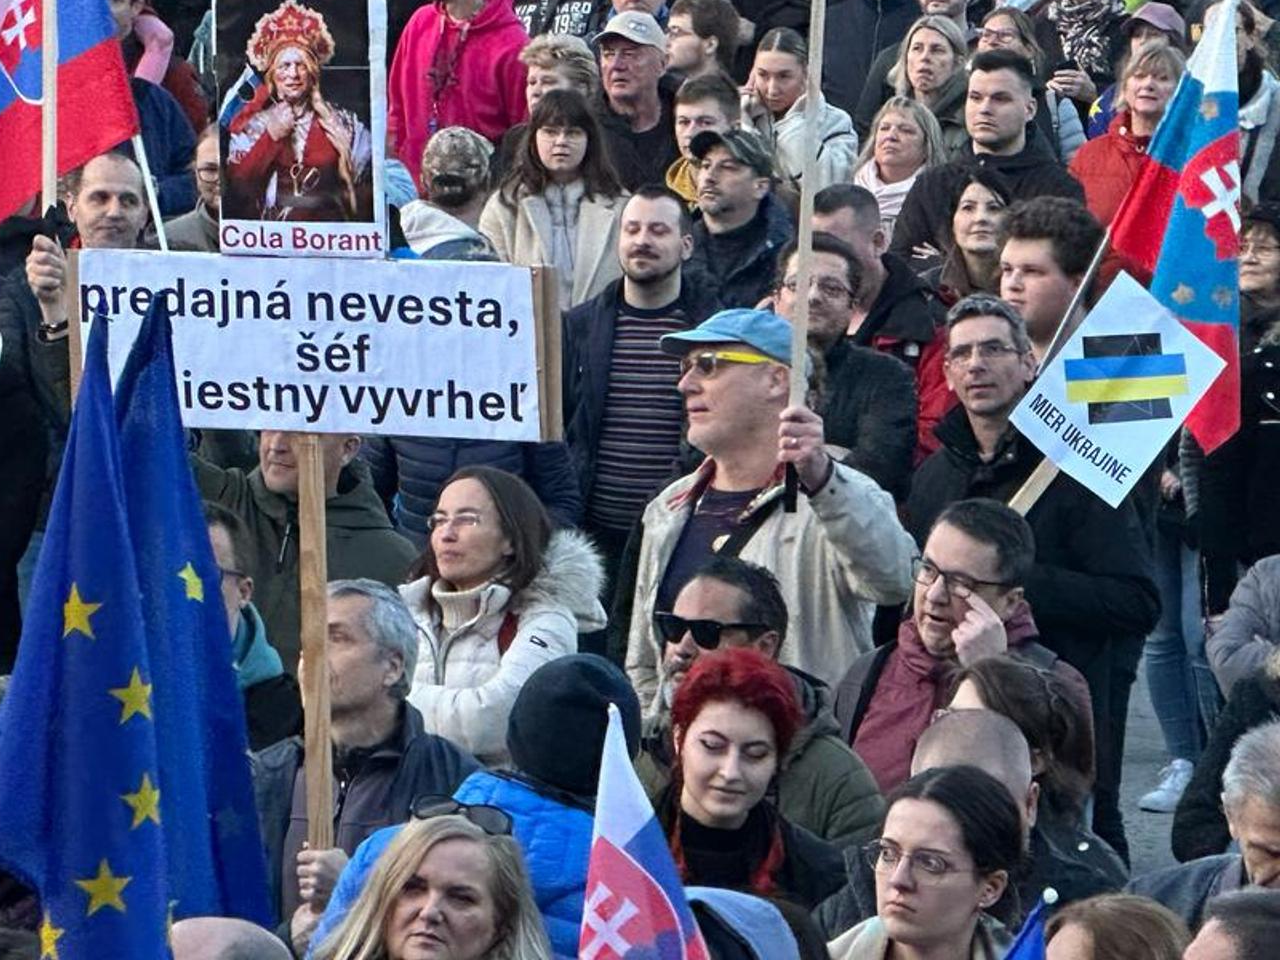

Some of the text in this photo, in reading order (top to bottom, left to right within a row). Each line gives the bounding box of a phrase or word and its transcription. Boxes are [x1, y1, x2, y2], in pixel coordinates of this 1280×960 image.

[221, 225, 383, 252] Cola Borant
[81, 278, 520, 338] predajná nevesta,
[296, 330, 372, 373] šéf
[339, 379, 528, 425] vyvrheľ
[1028, 393, 1132, 485] MIER UKRAJINE
